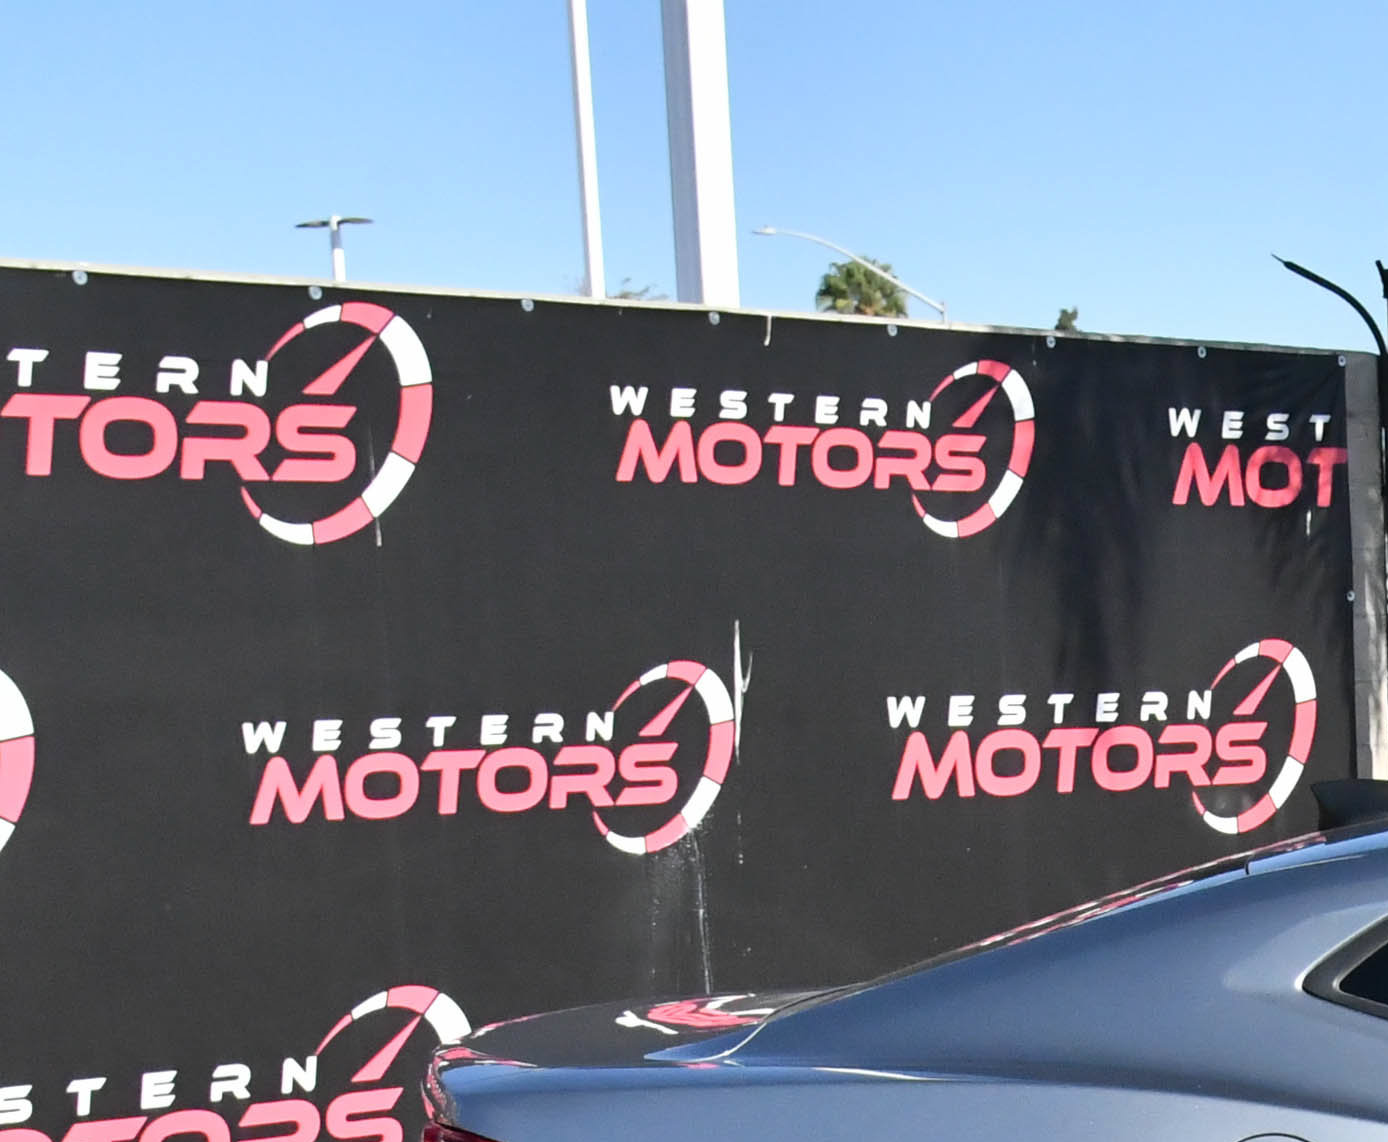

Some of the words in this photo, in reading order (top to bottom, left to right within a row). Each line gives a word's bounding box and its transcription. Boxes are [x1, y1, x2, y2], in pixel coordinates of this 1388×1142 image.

[609, 384, 932, 430] WESTERN
[1168, 407, 1331, 441] WEST
[616, 418, 987, 491] MOTORS
[1172, 442, 1347, 507] MOT
[241, 711, 615, 755] WESTERN
[886, 689, 1213, 729] WESTERN
[249, 741, 679, 825] MOTORS
[892, 721, 1268, 800] MOTORS
